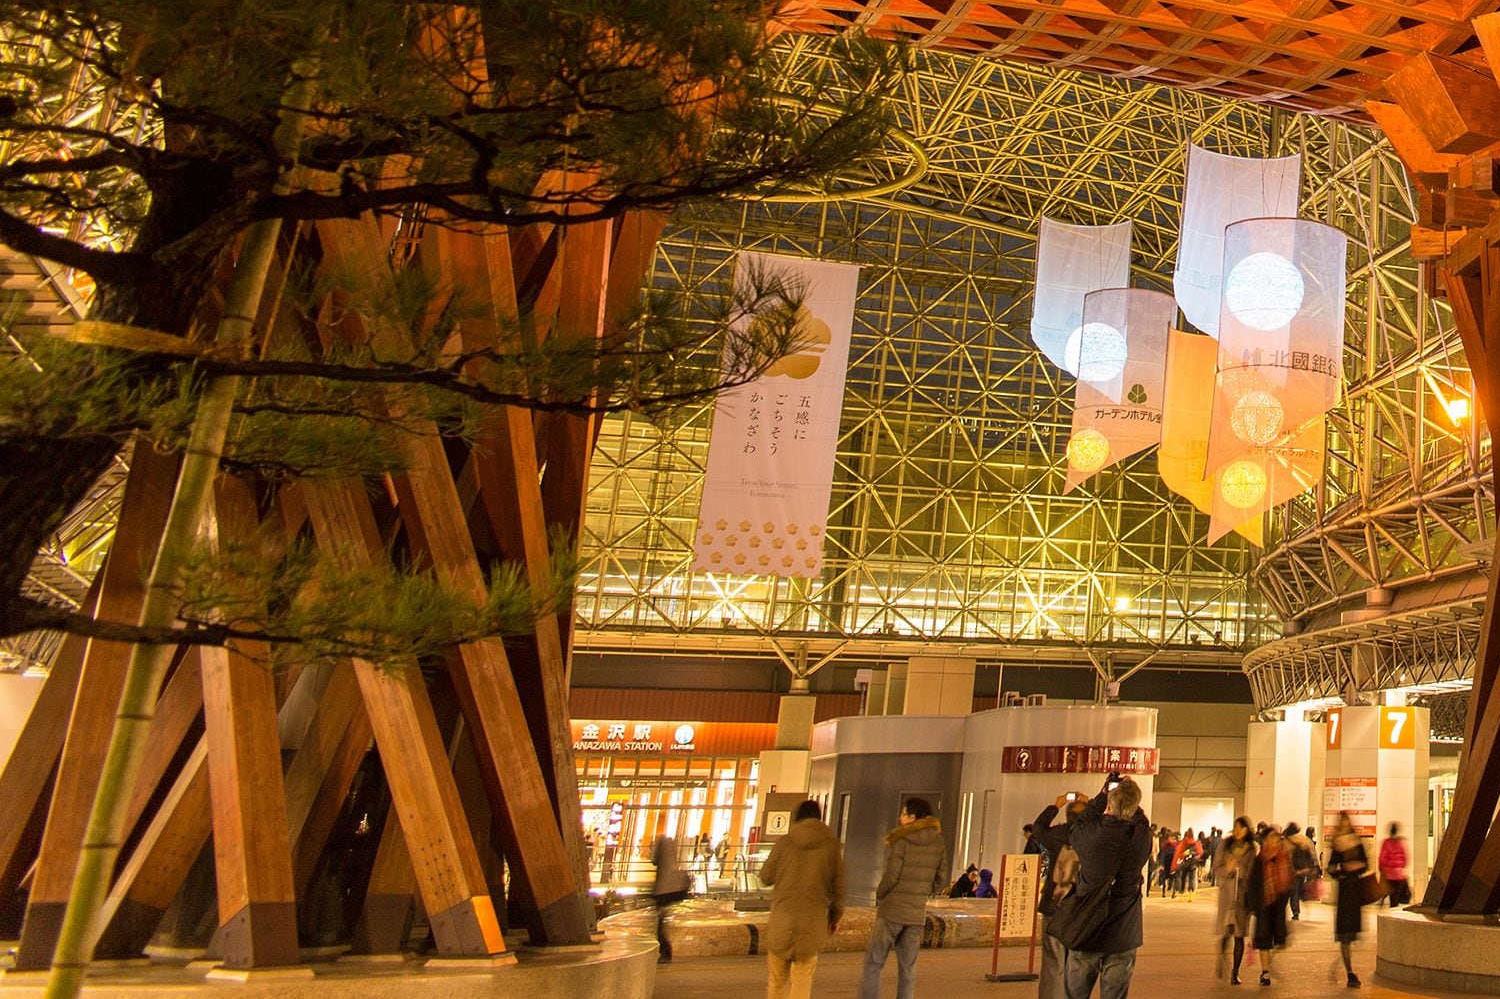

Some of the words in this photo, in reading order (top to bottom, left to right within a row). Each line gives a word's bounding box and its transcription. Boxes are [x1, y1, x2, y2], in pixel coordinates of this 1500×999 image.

[743, 392, 763, 454] かなざわ
[770, 394, 788, 456] ごちそう
[795, 395, 811, 440] 五感に
[582, 723, 652, 742] 金沢駅
[624, 742, 663, 751] STATION
[1387, 712, 1408, 744] 7
